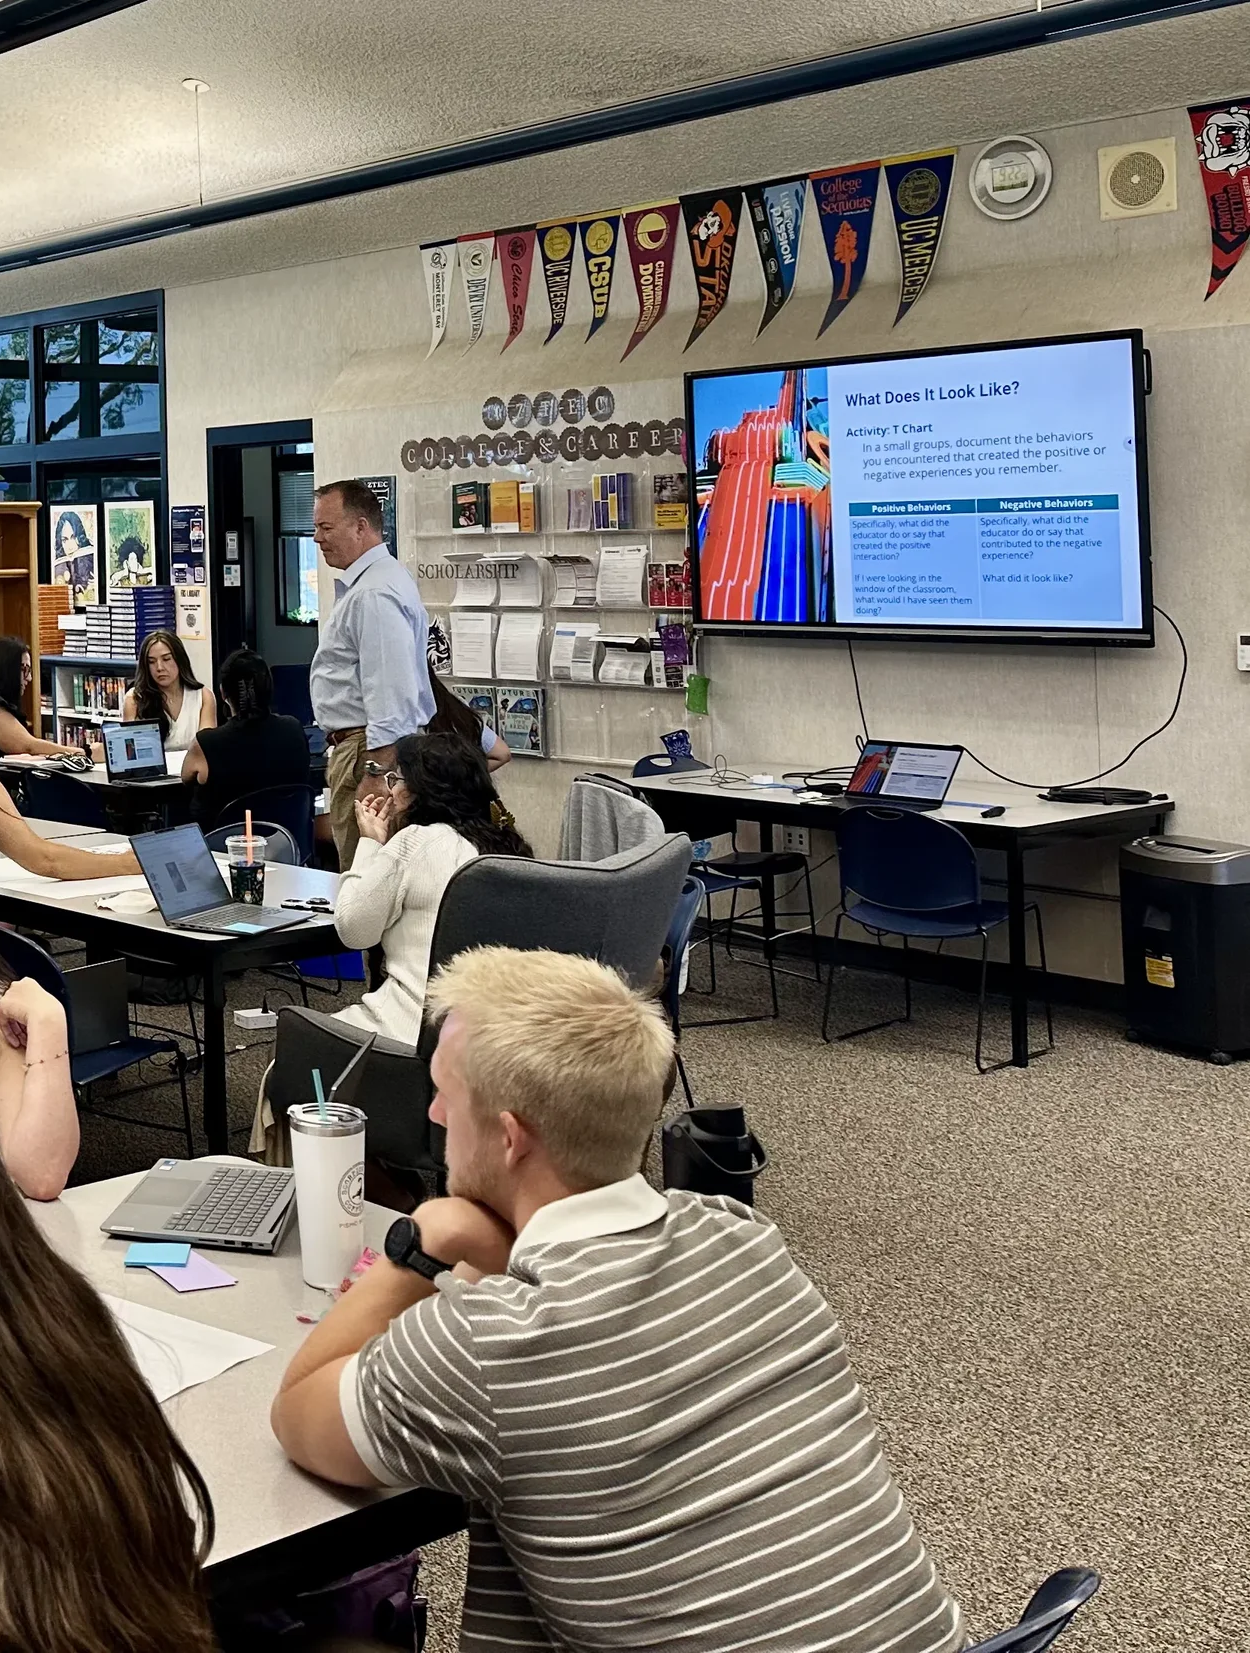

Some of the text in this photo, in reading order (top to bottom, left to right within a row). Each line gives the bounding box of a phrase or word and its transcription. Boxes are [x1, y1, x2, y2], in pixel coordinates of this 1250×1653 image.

[820, 177, 862, 194] College
[821, 196, 872, 215] Sequoias
[780, 192, 796, 240] LIVE YOUR
[771, 206, 795, 265] PASSION
[901, 215, 939, 241] UC
[545, 260, 570, 276] UC
[902, 241, 935, 303] MERCED
[511, 263, 523, 298] Chico
[588, 256, 612, 318] CSUB
[692, 239, 720, 327] STATE
[467, 278, 487, 303] DEVRY
[548, 274, 569, 324] RIVERSIDE
[845, 381, 1020, 407] What Does It Look Like?
[846, 424, 933, 438] Activity: T Chart
[407, 427, 683, 464] COLLEGE & CAREER
[862, 442, 872, 453] In
[883, 440, 911, 452] small
[913, 441, 953, 453] groups,
[955, 435, 1012, 448] document
[1014, 433, 1033, 445] the
[1036, 431, 1094, 443] behaviors
[863, 445, 1106, 469] you encountered that created the positive or
[864, 463, 1063, 482] negative experiences you remember.
[872, 503, 951, 513] Positive Behaviors
[1000, 499, 1094, 511] Negative Behaviors
[852, 518, 950, 530] Specifically, what did the
[980, 516, 1089, 527] Specifically, what did the
[852, 531, 888, 540] educator
[889, 531, 900, 539] do
[913, 532, 926, 541] say
[928, 530, 945, 538] that
[981, 529, 1020, 537] educator
[1022, 528, 1034, 537] do
[1048, 530, 1063, 538] say
[1065, 528, 1084, 536] that
[853, 541, 931, 551] created the positive
[981, 540, 1032, 549] contributed
[1046, 540, 1061, 548] the
[1063, 539, 1103, 549] negative
[854, 553, 900, 561] interaction?
[981, 551, 1034, 561] experience?
[418, 563, 520, 579] SCHOLARSHIP
[854, 574, 861, 582] If
[862, 574, 865, 582] I
[887, 574, 917, 584] looking
[919, 574, 927, 582] in
[928, 574, 942, 582] the
[982, 573, 1073, 583] What did it look like?
[855, 585, 957, 594] window of the classroom,
[855, 596, 876, 604] what
[877, 596, 901, 604] would
[903, 596, 906, 604] I
[907, 596, 927, 604] have
[950, 597, 973, 605] them
[856, 606, 882, 617] doing?
